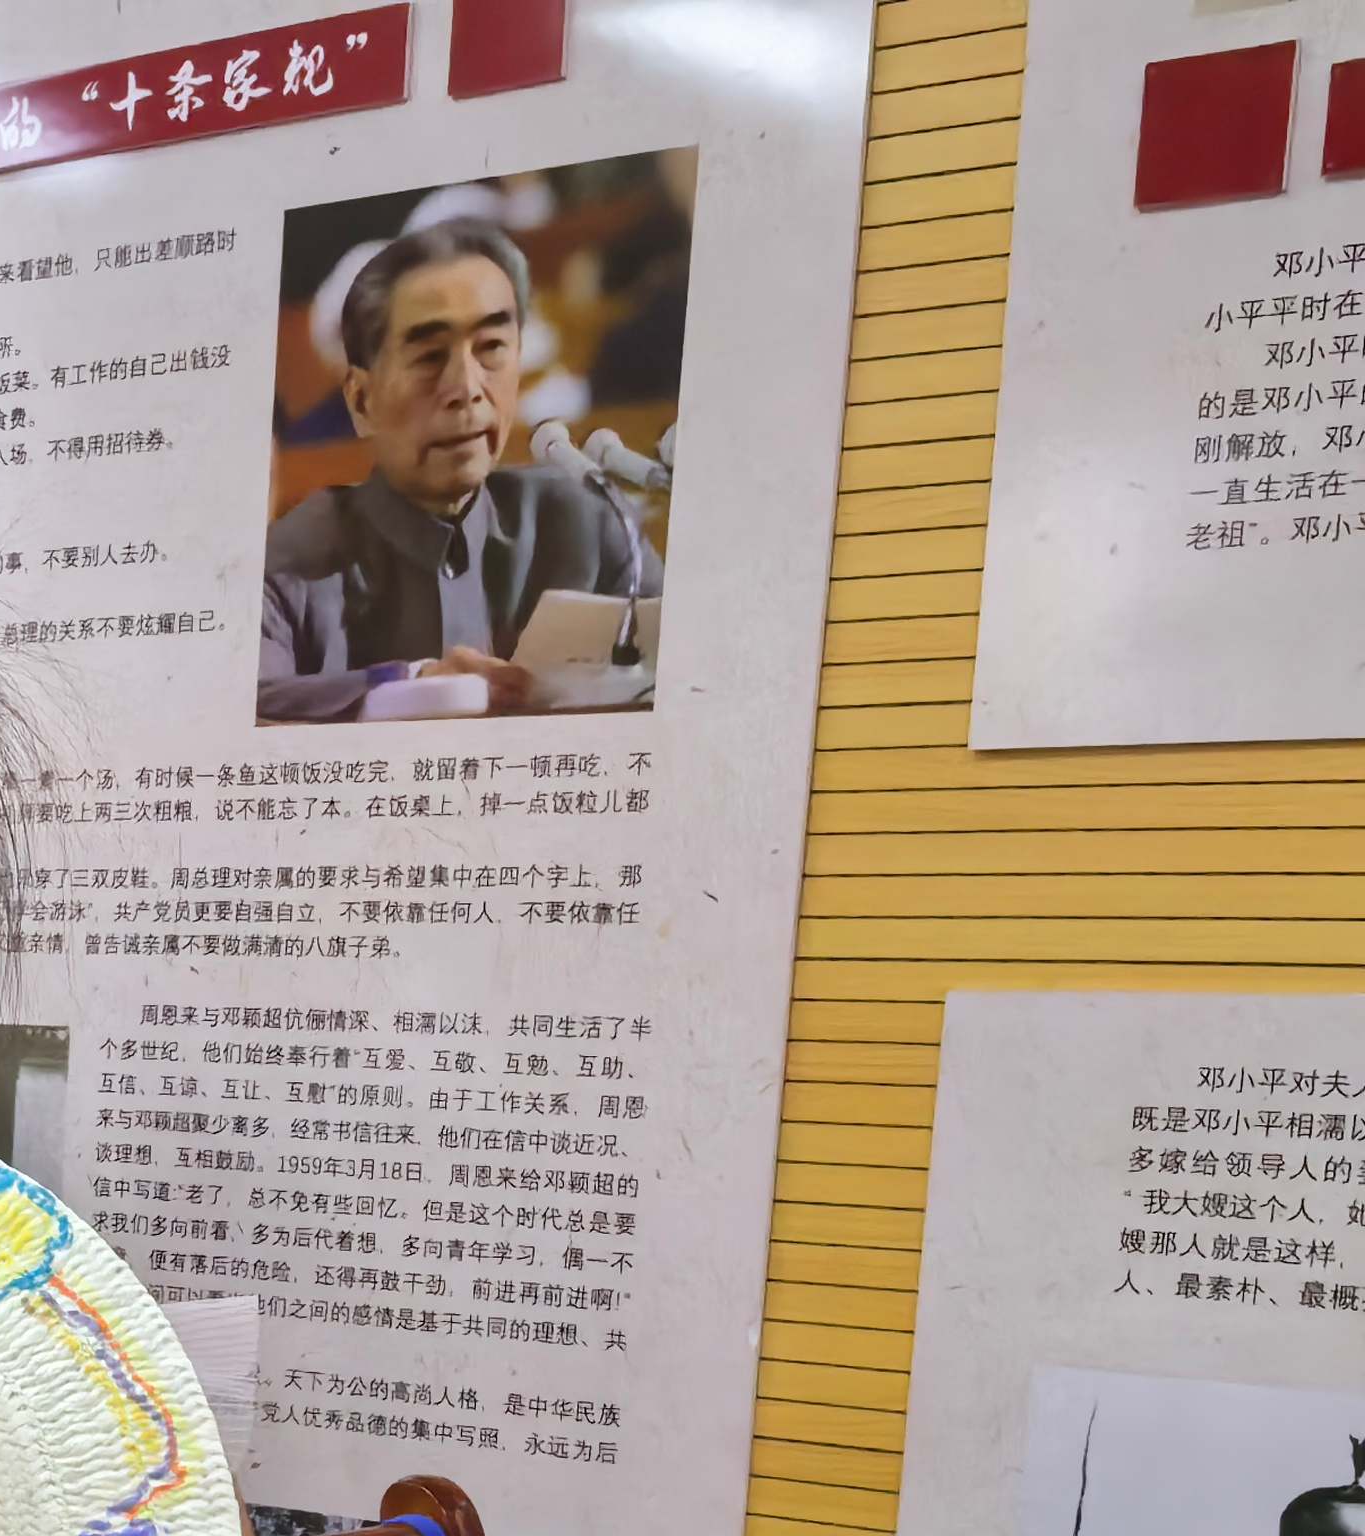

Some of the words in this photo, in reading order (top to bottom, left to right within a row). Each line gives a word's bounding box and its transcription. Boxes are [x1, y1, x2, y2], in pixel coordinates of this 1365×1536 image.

[1265, 334, 1365, 369] 邓小平
[1198, 379, 1365, 420] 的是邓小平
[1114, 1269, 1365, 1313] 人、最素朴、最概
